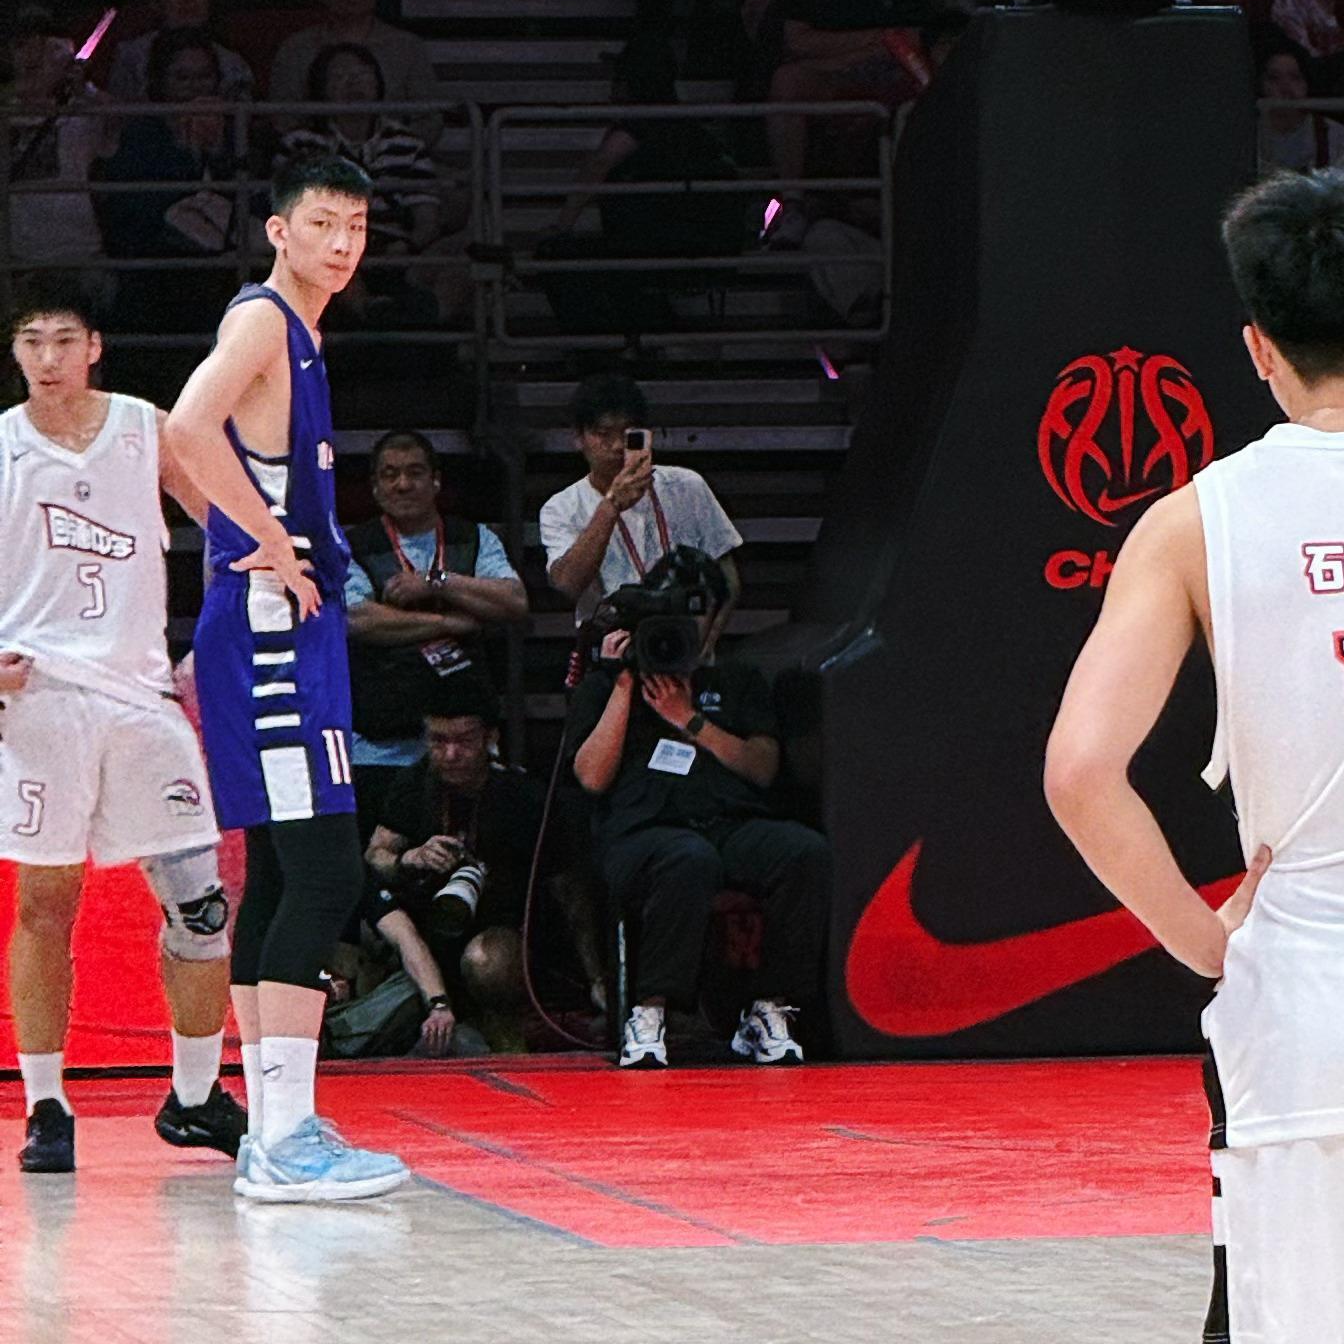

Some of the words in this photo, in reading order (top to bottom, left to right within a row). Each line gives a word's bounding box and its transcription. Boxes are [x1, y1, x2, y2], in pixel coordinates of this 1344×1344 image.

[77, 563, 107, 619] 5
[321, 729, 352, 786] 11
[13, 779, 46, 836] 5
